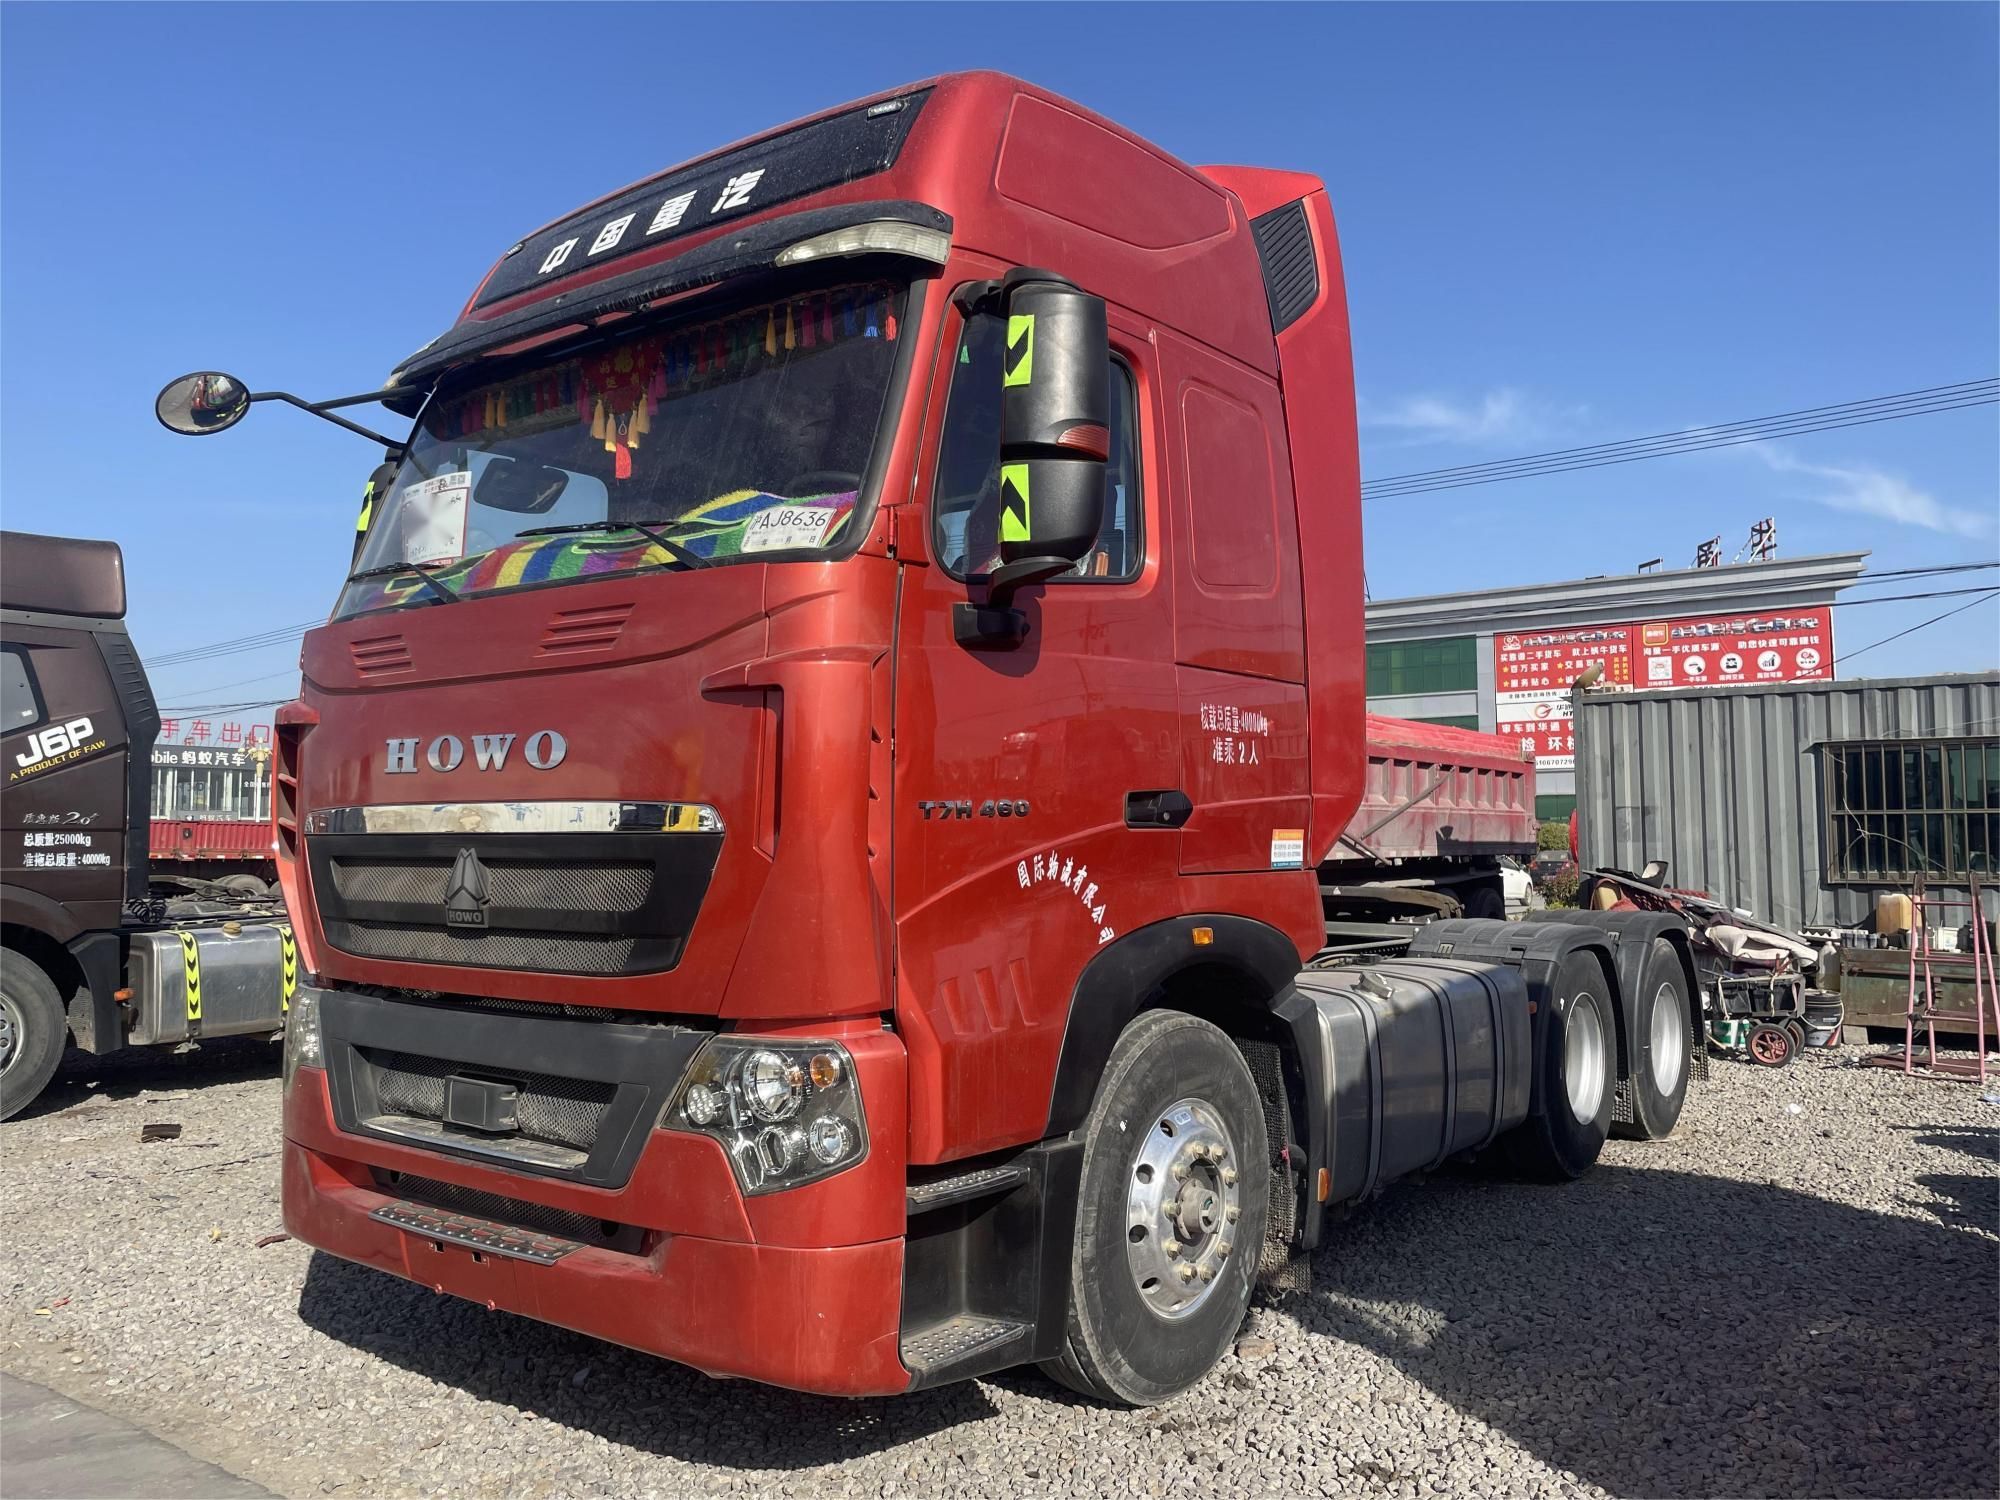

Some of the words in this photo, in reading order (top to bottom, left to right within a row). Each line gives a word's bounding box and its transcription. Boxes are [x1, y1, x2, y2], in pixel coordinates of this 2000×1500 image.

[538, 169, 766, 275] 中国重汽
[10, 772, 19, 781] A
[20, 754, 66, 777] PRODUCT
[69, 748, 82, 760] OF
[84, 739, 106, 754] FAW
[16, 717, 94, 768] J6P
[151, 750, 178, 764] bile
[181, 750, 246, 766] 蚂蚁汽车
[384, 730, 567, 774] HOWO
[918, 800, 972, 820] T7H
[979, 799, 1030, 818] 460
[24, 833, 92, 846] 总质量25000kg
[449, 910, 482, 923] HOWO
[1017, 850, 1115, 945] 国际物流有限公司
